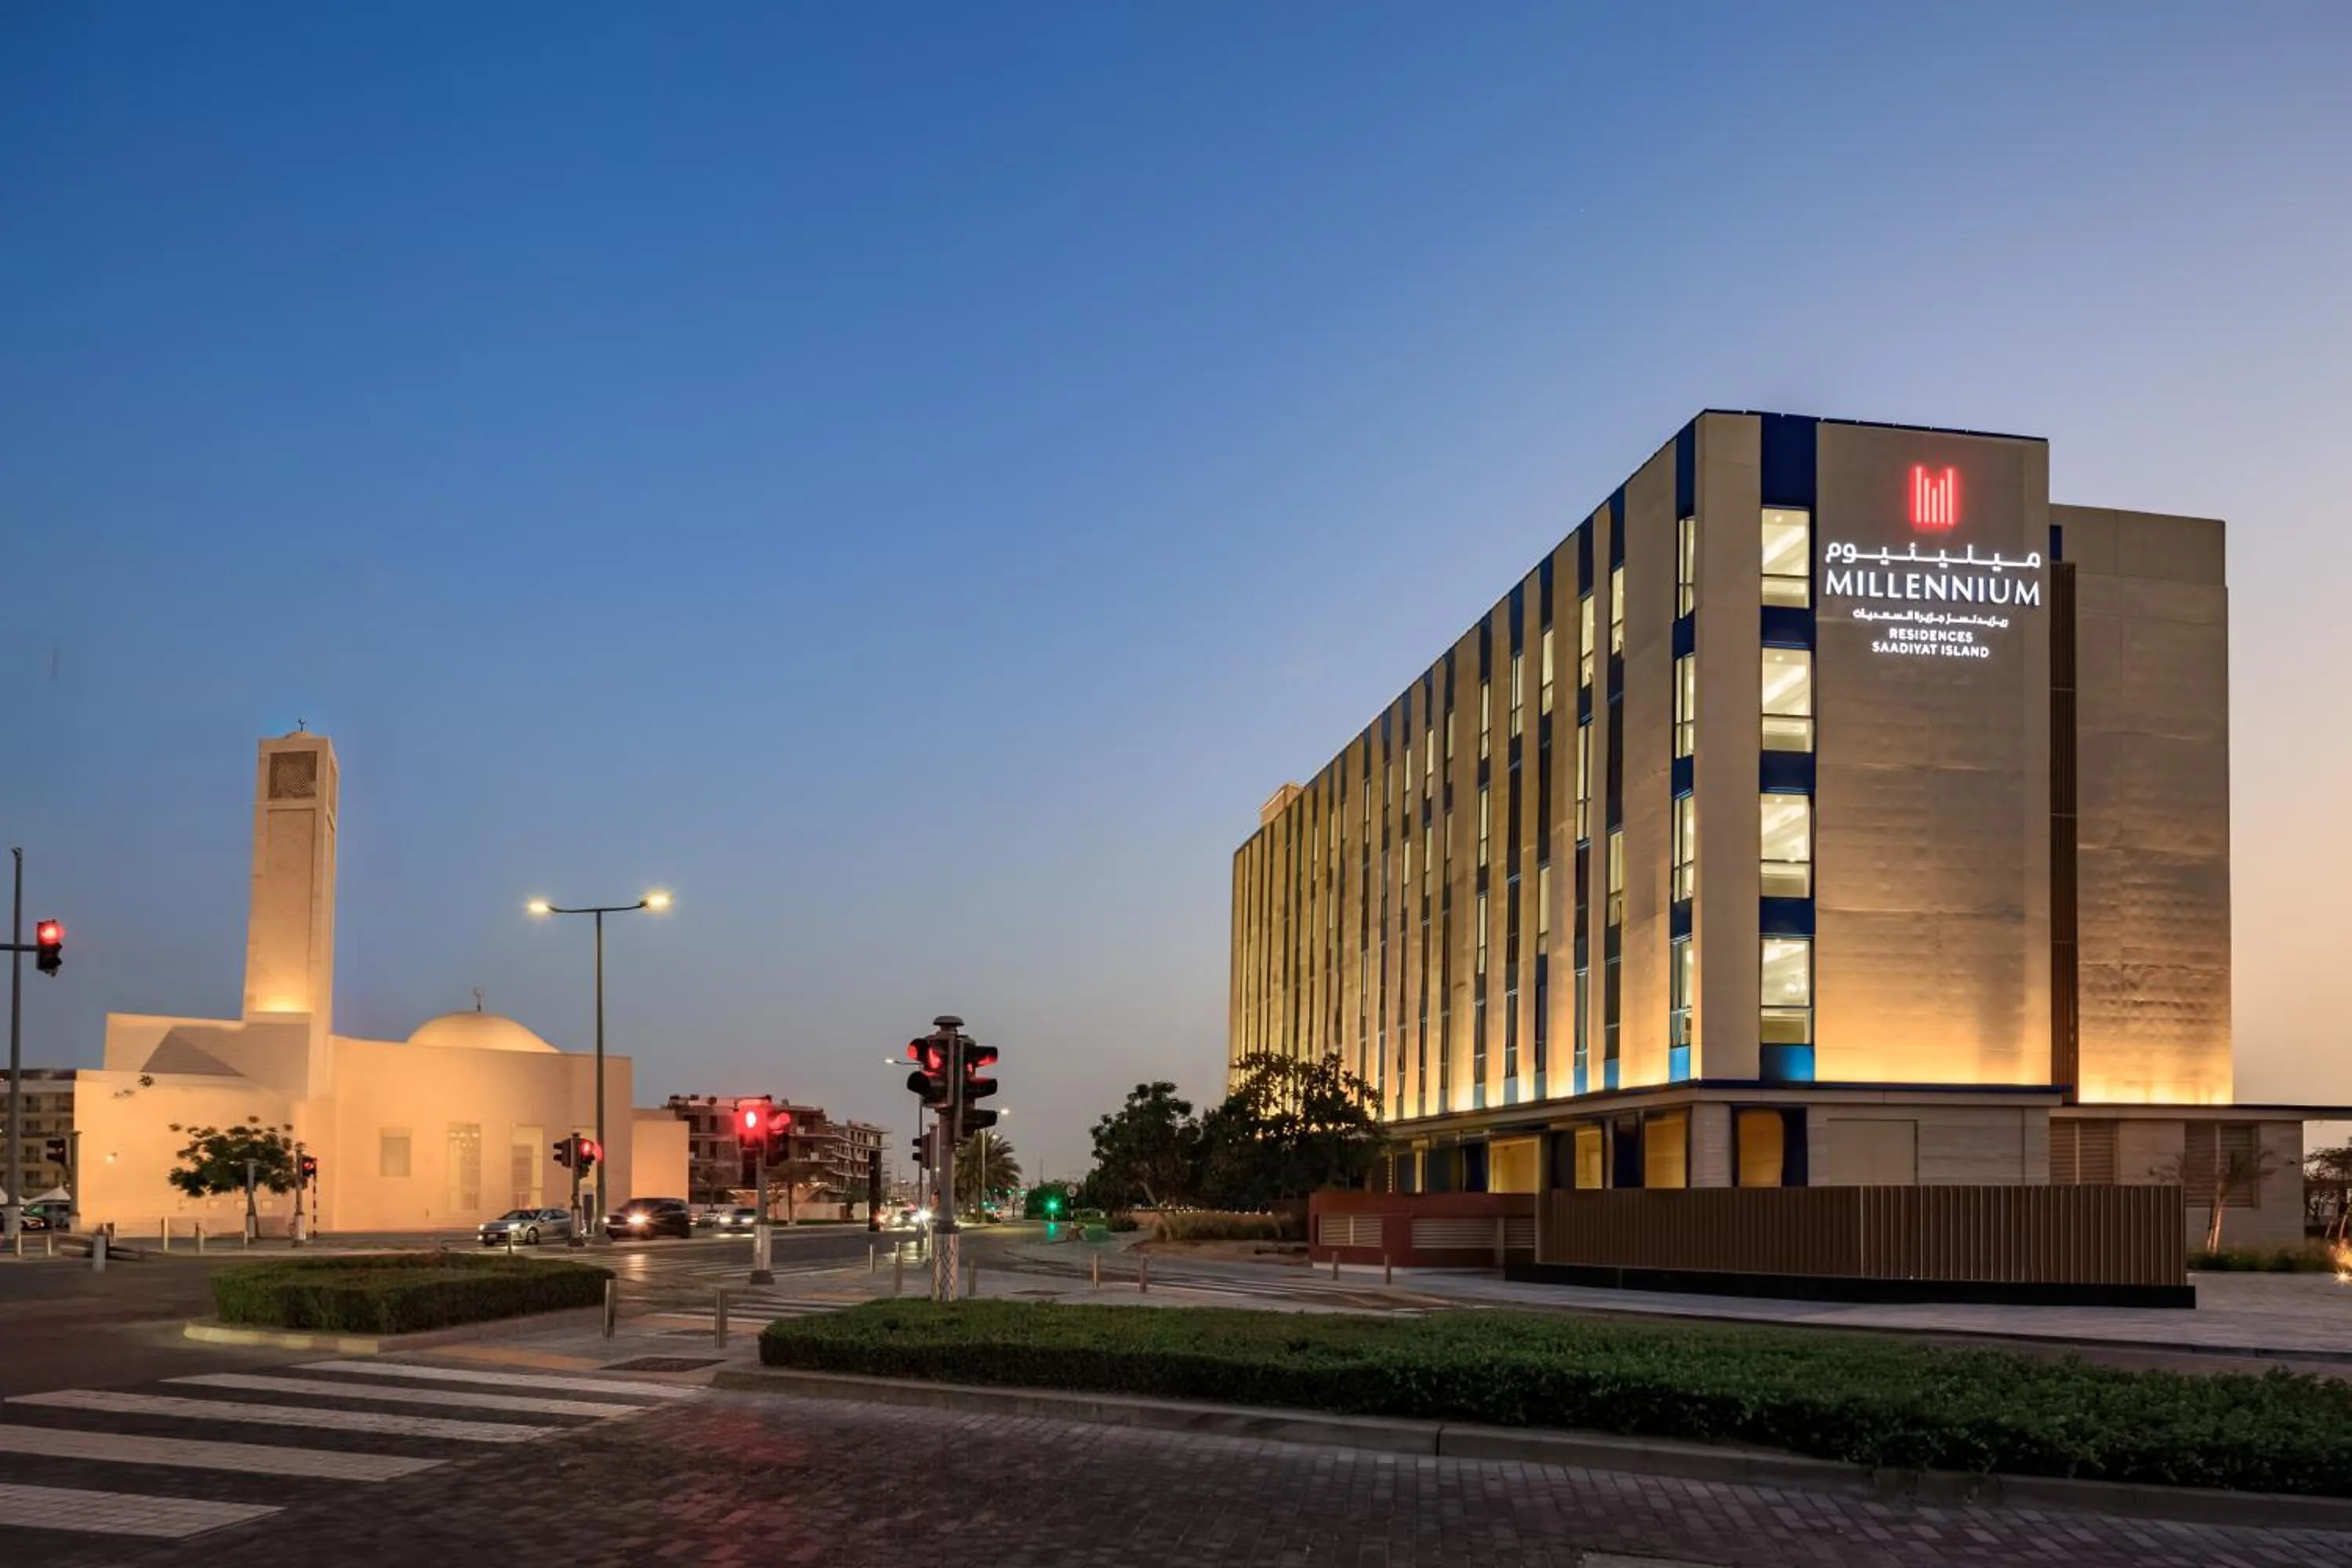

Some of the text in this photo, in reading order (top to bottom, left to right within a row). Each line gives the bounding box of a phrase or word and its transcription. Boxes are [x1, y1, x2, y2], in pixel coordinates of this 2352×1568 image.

[1825, 570, 2040, 605] MILLENNIUM
[1889, 628, 1973, 643] RESIDENCES
[1871, 641, 1989, 659] SAADIYAT ISLAND
